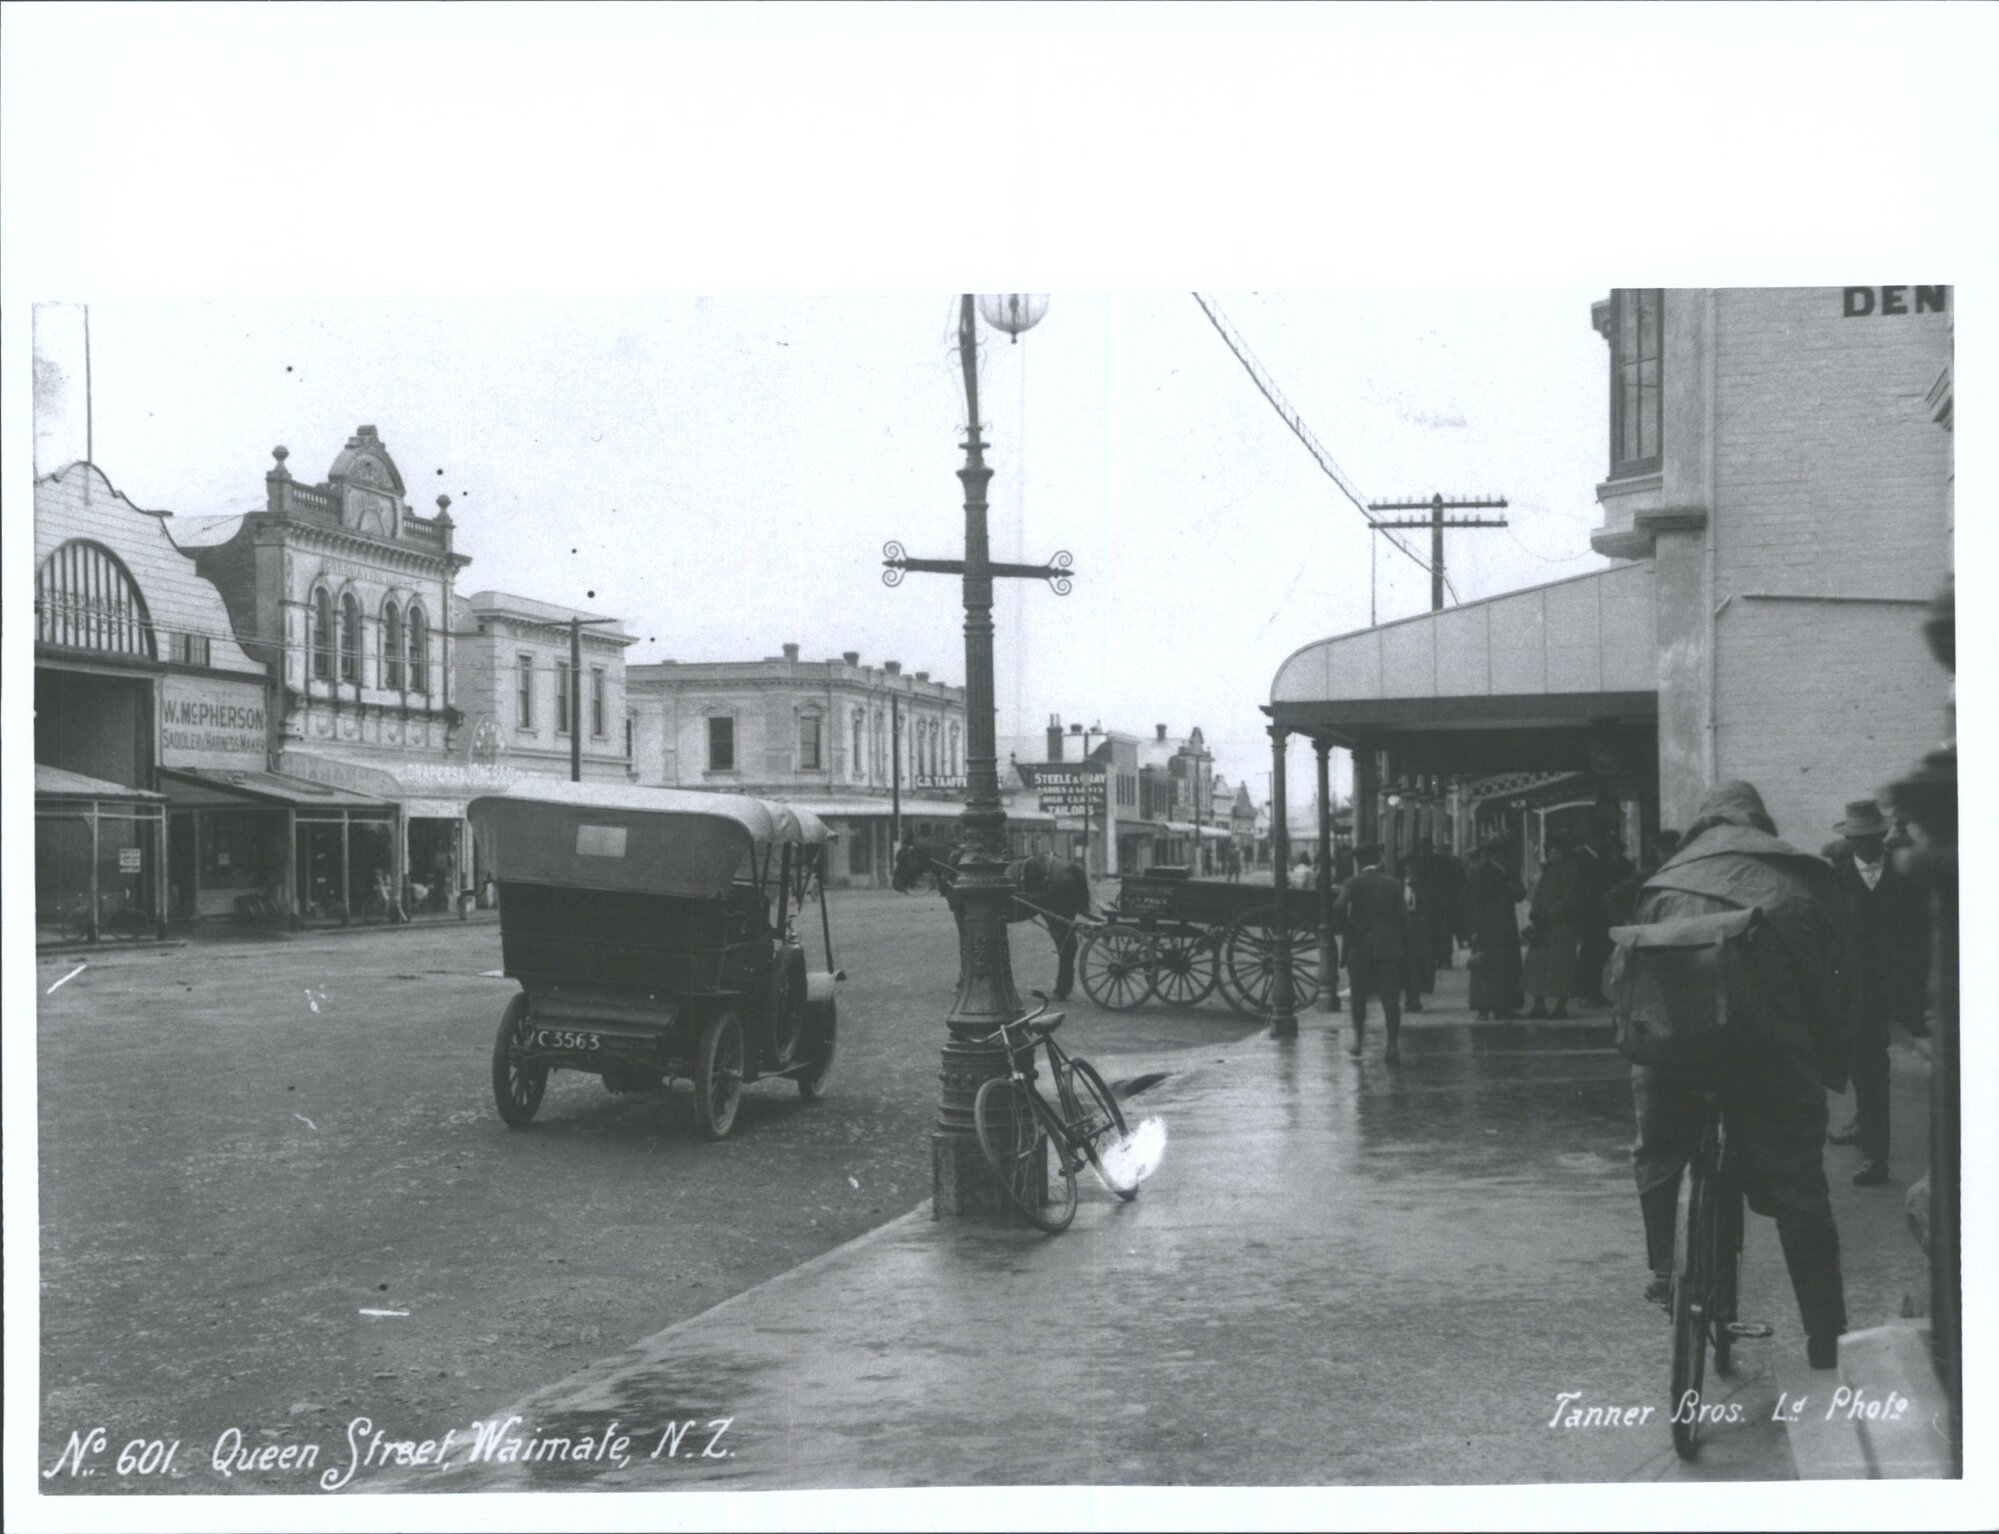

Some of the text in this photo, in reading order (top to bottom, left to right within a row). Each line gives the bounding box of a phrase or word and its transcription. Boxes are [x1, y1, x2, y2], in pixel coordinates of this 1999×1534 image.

[1843, 285, 1946, 317] DEN
[163, 700, 179, 725] W.
[162, 728, 202, 750] SADDLER
[1034, 773, 1072, 785] STEELE
[1047, 805, 1095, 817] TAILORS
